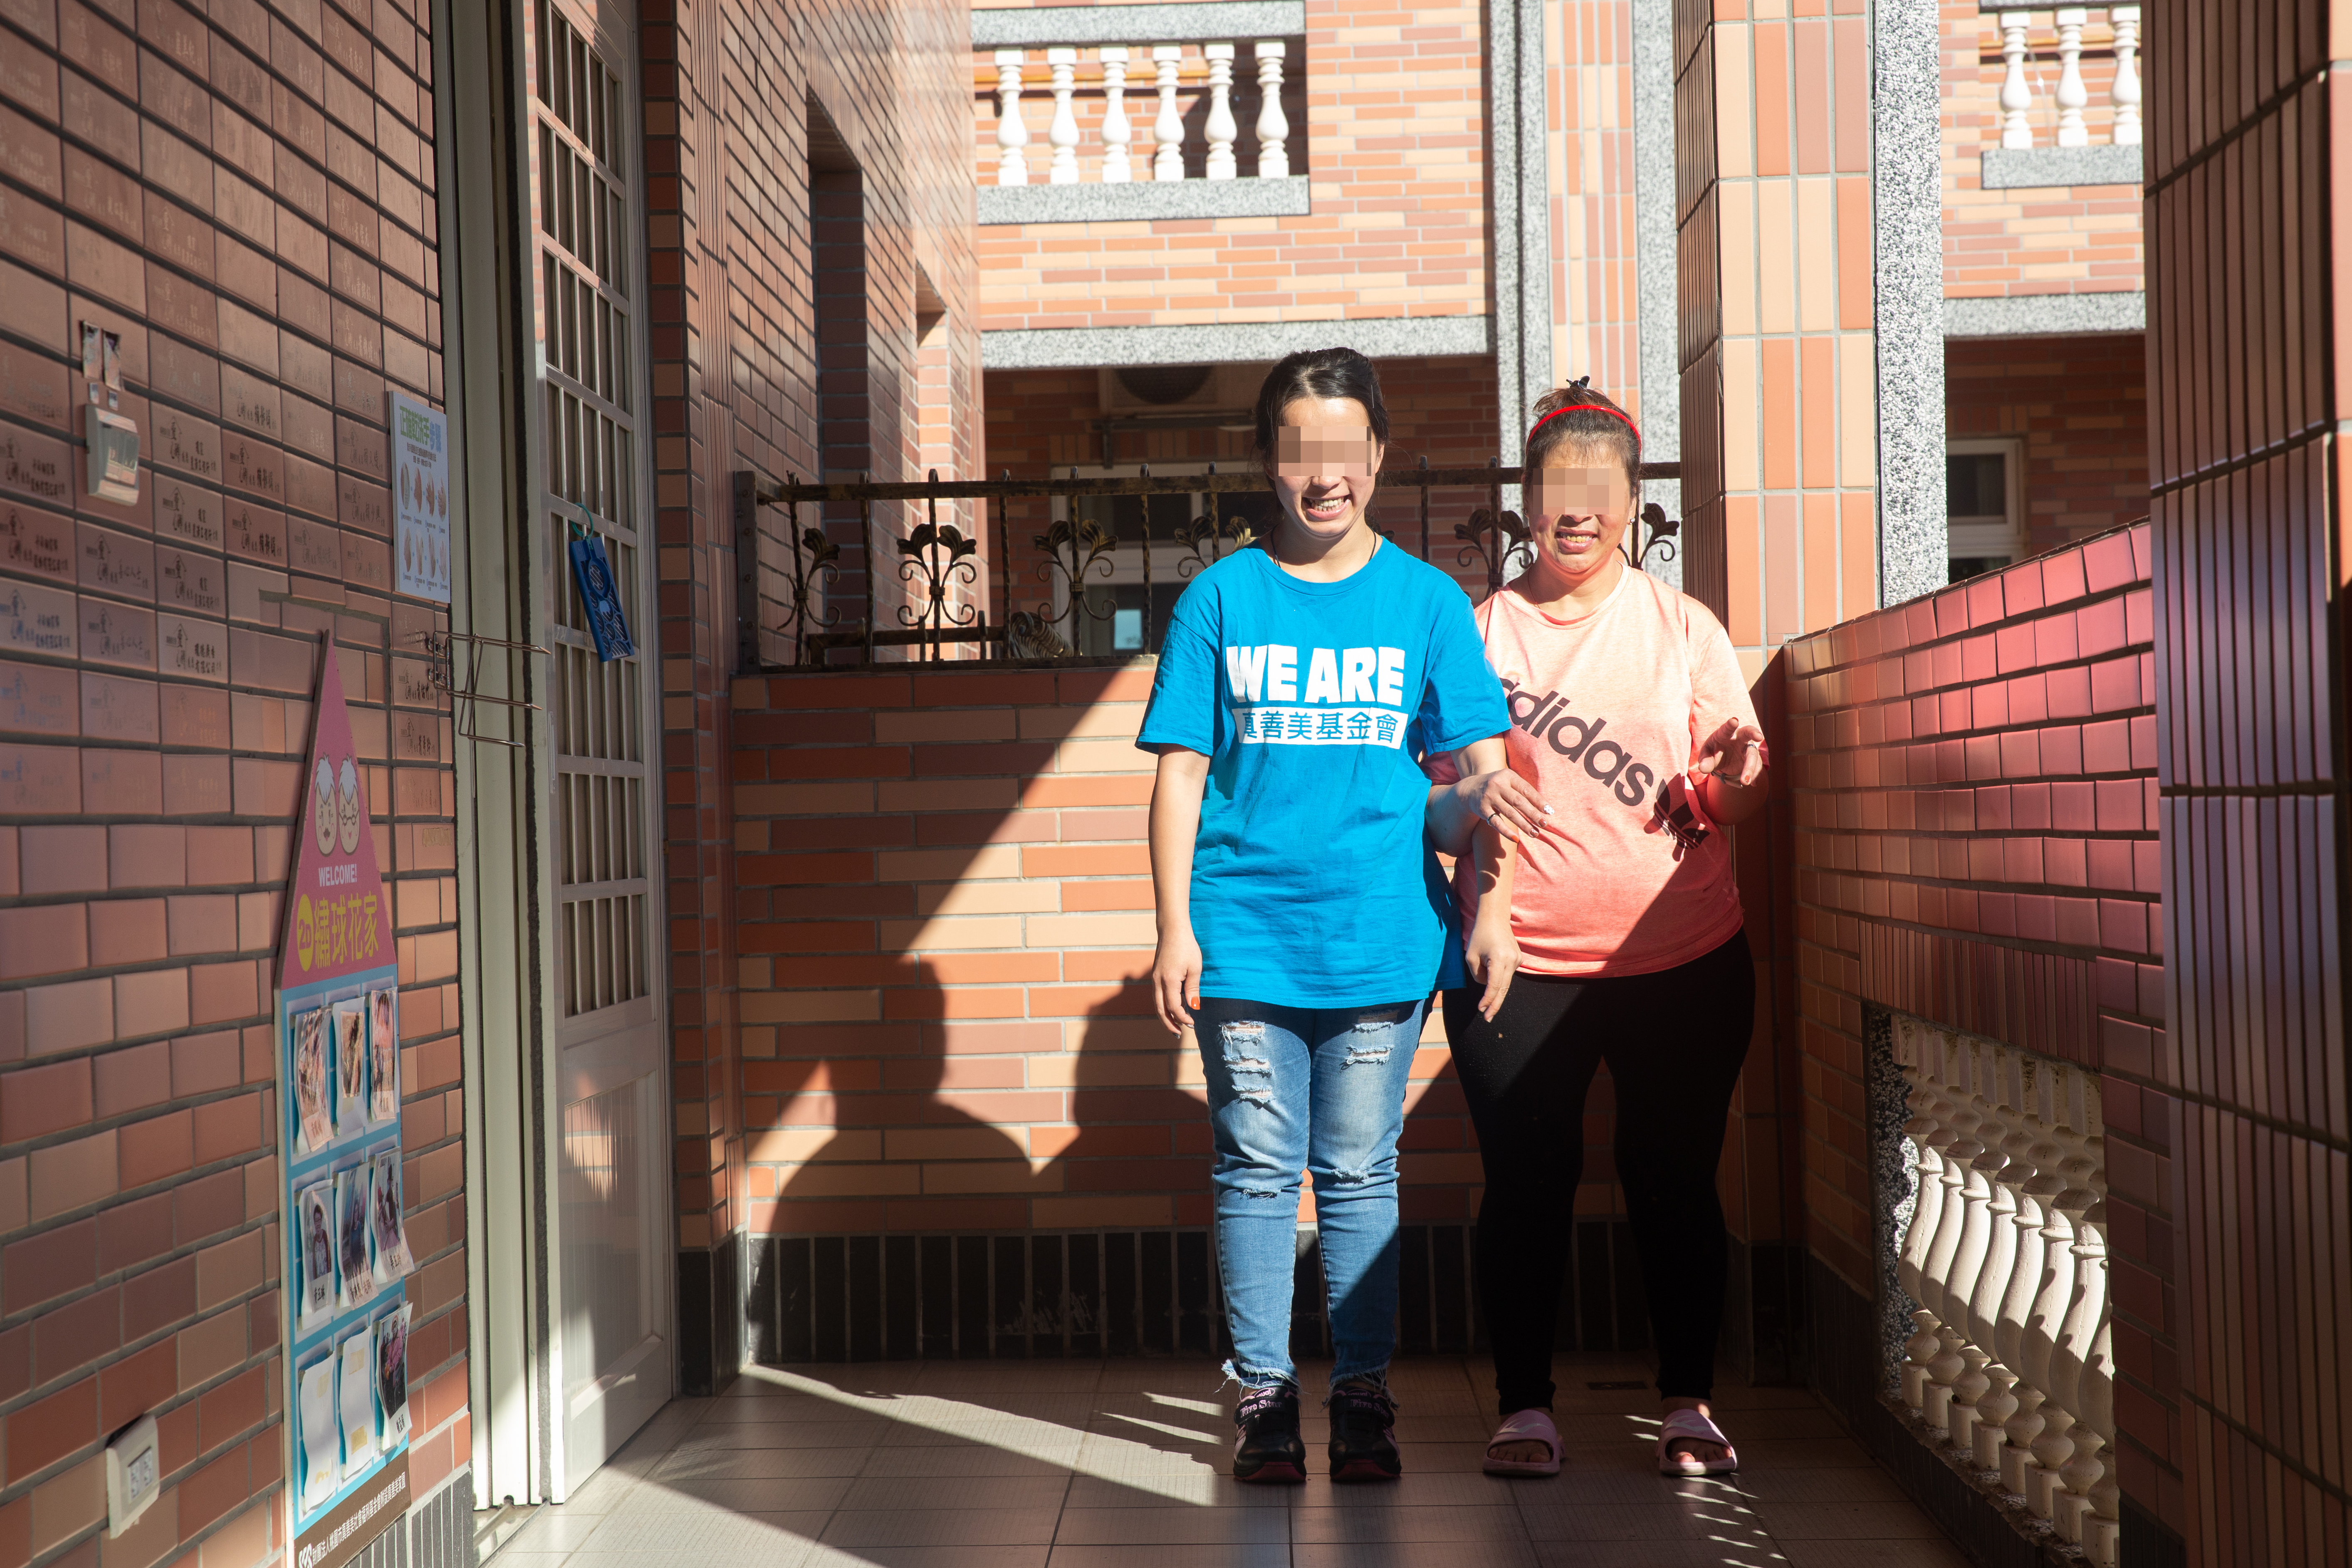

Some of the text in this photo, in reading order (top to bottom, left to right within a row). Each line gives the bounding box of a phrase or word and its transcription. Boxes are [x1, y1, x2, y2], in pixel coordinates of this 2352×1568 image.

[1226, 644, 1405, 706] WE ARE
[1242, 710, 1398, 743] 真善美基金會
[318, 864, 357, 887] WELCOME!
[299, 890, 378, 969] 2D 繡球花家
[1240, 1400, 1282, 1418] Five Star
[1350, 1399, 1390, 1419] Five Star
